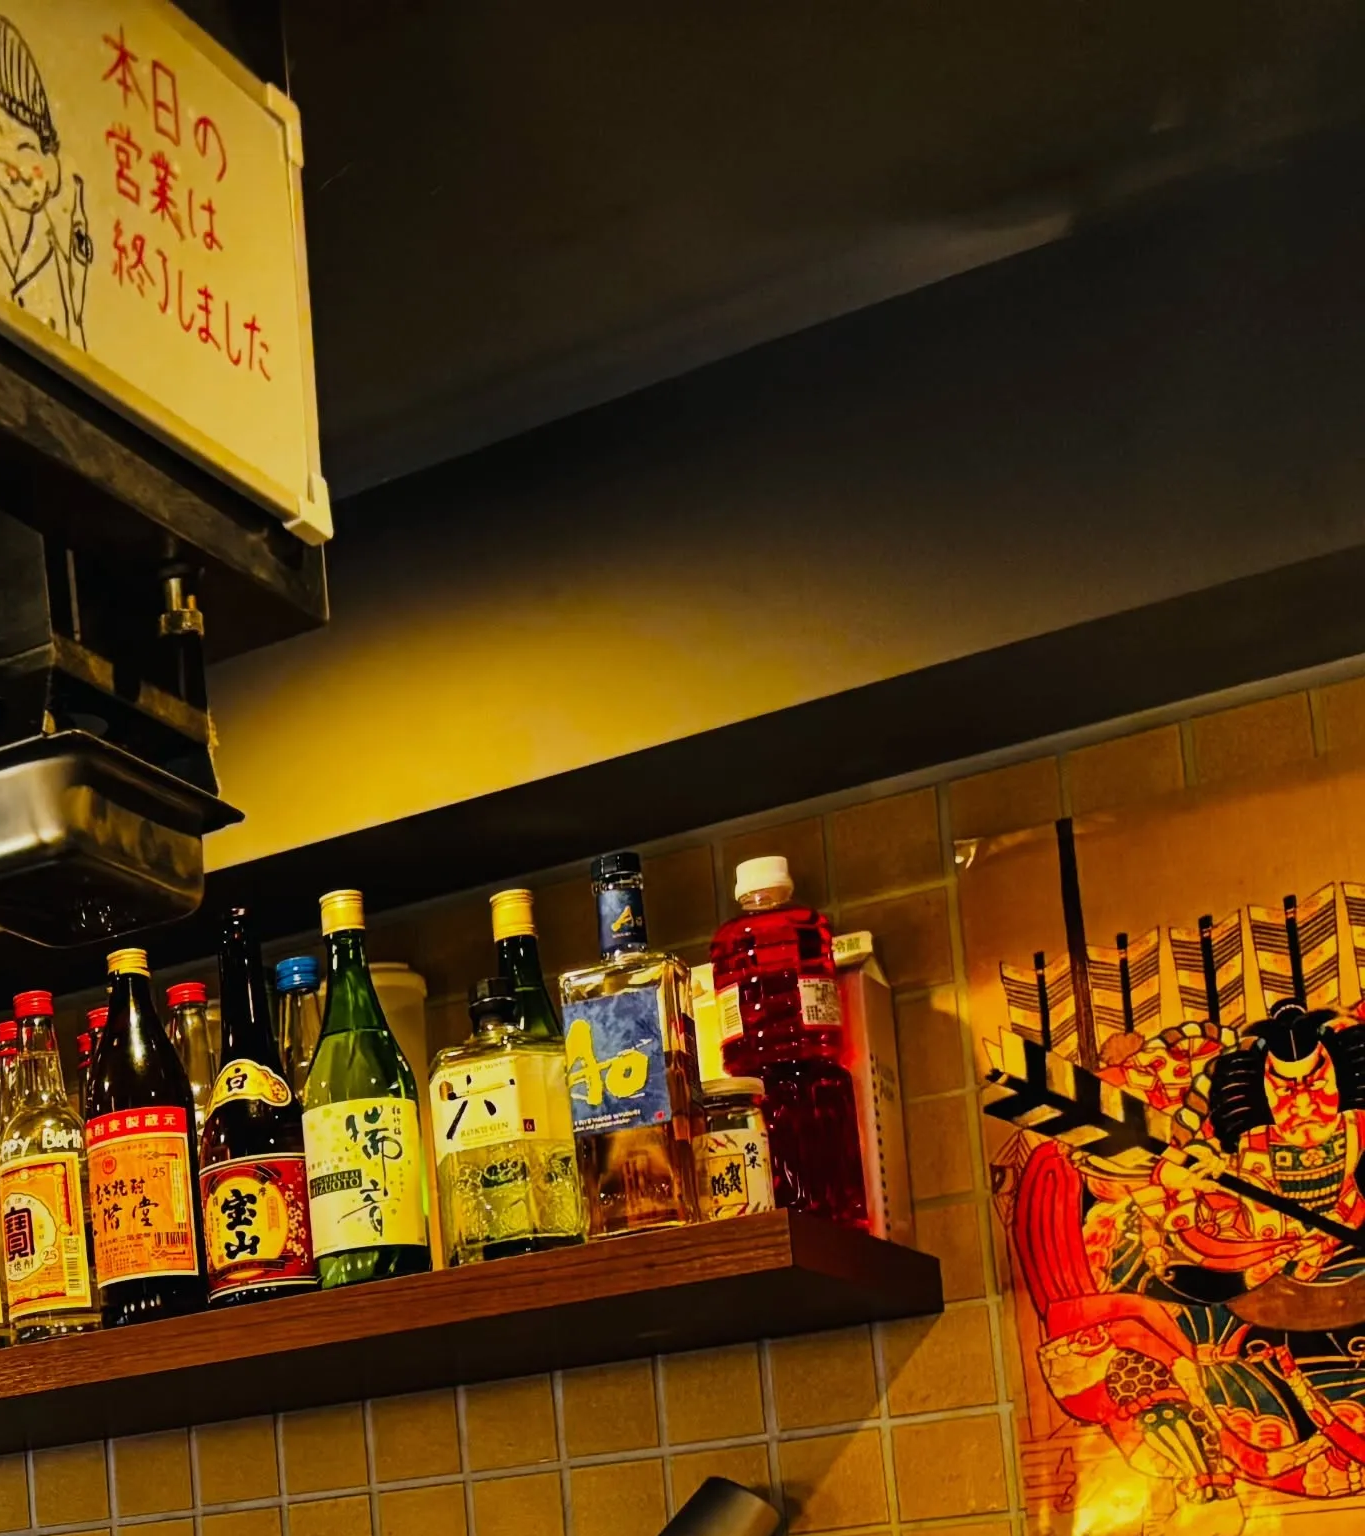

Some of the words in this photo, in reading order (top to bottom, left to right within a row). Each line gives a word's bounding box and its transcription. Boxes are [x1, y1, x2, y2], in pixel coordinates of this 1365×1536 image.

[101, 24, 227, 183] 本日の
[105, 122, 224, 252] 営業は
[111, 217, 272, 382] 終了しました
[566, 1018, 649, 1107] Ao
[445, 1073, 517, 1141] 六
[151, 1166, 167, 1179] 25
[744, 1141, 762, 1169] 純米
[3, 1206, 36, 1263] 寶
[42, 1250, 58, 1262] 25
[220, 1188, 261, 1261] 宝山
